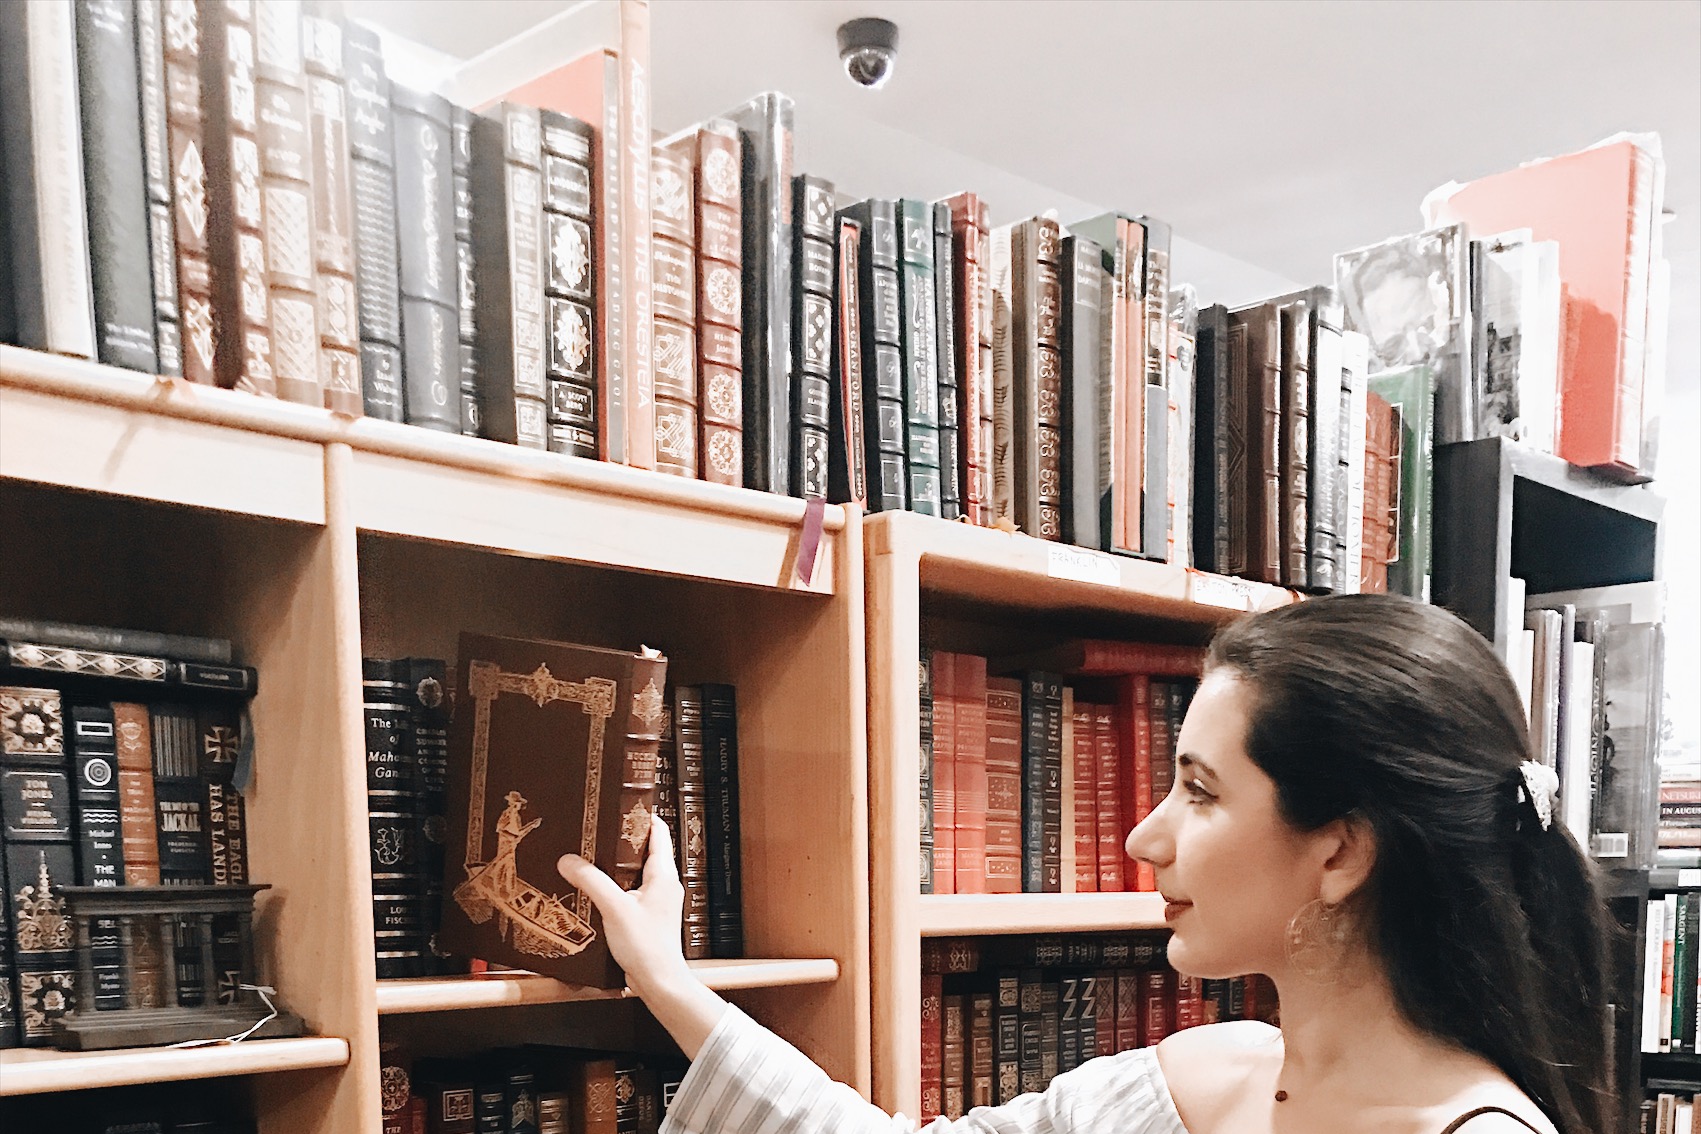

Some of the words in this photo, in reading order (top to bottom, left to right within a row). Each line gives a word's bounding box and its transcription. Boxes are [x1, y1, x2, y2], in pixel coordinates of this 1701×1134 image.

[608, 149, 619, 225] BALLAD
[610, 232, 620, 254] OF
[611, 264, 621, 351] READING
[635, 292, 651, 409] ORESTEIA
[926, 333, 934, 361] AND
[612, 359, 621, 407] GAOL
[850, 331, 860, 411] CRANFORD
[370, 717, 392, 729] The
[389, 735, 400, 746] of
[21, 789, 54, 800] JONES
[24, 780, 49, 789] TOM
[208, 783, 224, 823] HAS
[721, 788, 731, 832] TRUMAN
[1662, 806, 1673, 815] IN
[161, 812, 202, 833] JACKAL
[94, 864, 116, 875] THE
[211, 829, 228, 886] LAND
[228, 838, 243, 886] EAGL
[93, 878, 117, 888] MAN
[1677, 904, 1688, 946] SARGENT
[385, 1126, 402, 1134] THE
